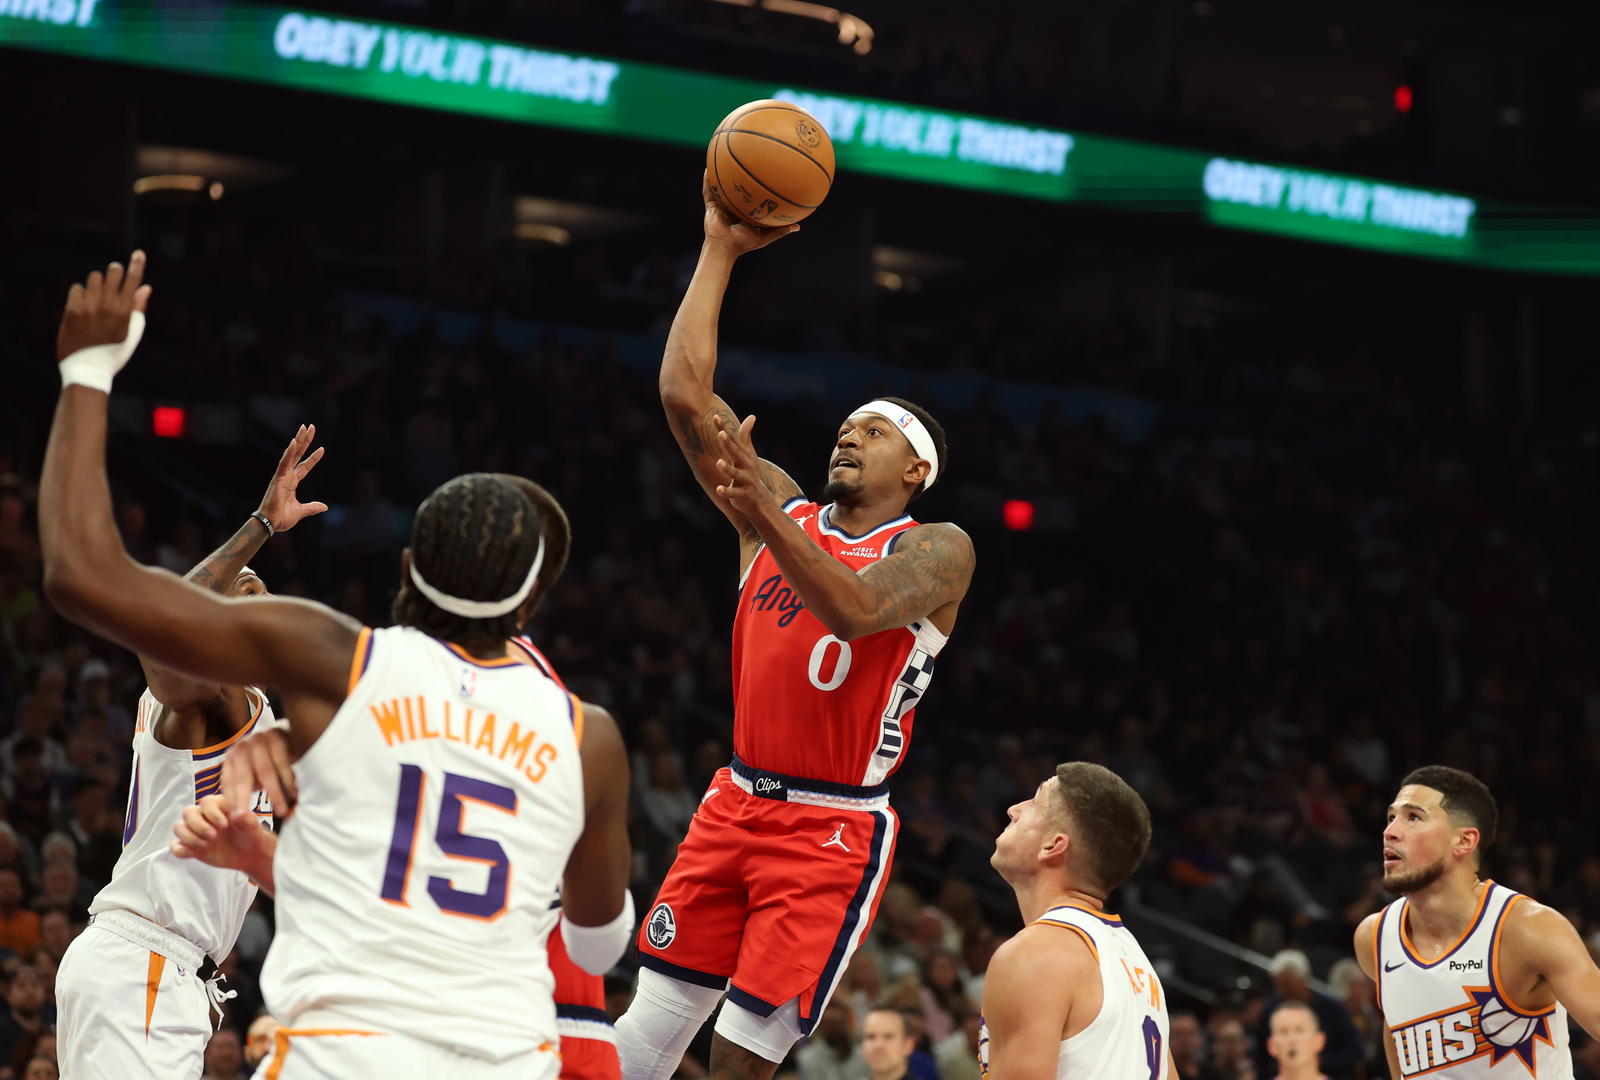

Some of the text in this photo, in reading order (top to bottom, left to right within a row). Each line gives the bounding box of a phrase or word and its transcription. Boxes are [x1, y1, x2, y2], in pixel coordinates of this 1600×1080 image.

[274, 12, 381, 70] OBEY
[485, 43, 620, 106] THIRST
[955, 116, 1075, 176] THIRST
[840, 550, 878, 559] RWANDA
[807, 634, 853, 692] 0
[369, 695, 558, 783] WILLIAMS
[756, 777, 782, 795] Clips
[379, 762, 520, 922] 15
[1449, 959, 1483, 972] PayPal
